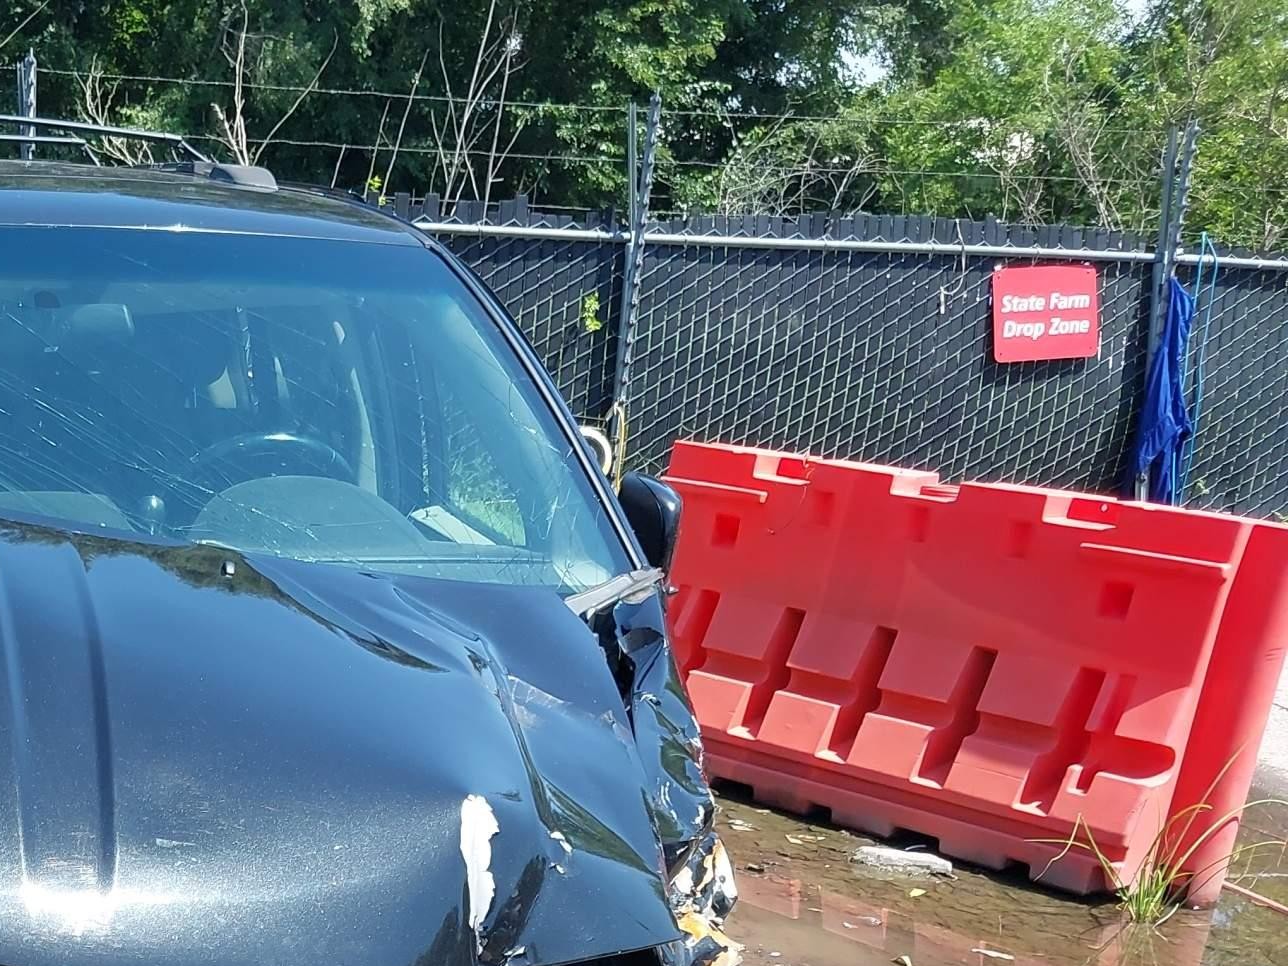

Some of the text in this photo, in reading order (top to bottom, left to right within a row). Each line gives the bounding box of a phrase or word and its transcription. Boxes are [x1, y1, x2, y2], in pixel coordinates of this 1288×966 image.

[1000, 292, 1091, 313] State Farm
[1003, 317, 1090, 341] Drop Zone
